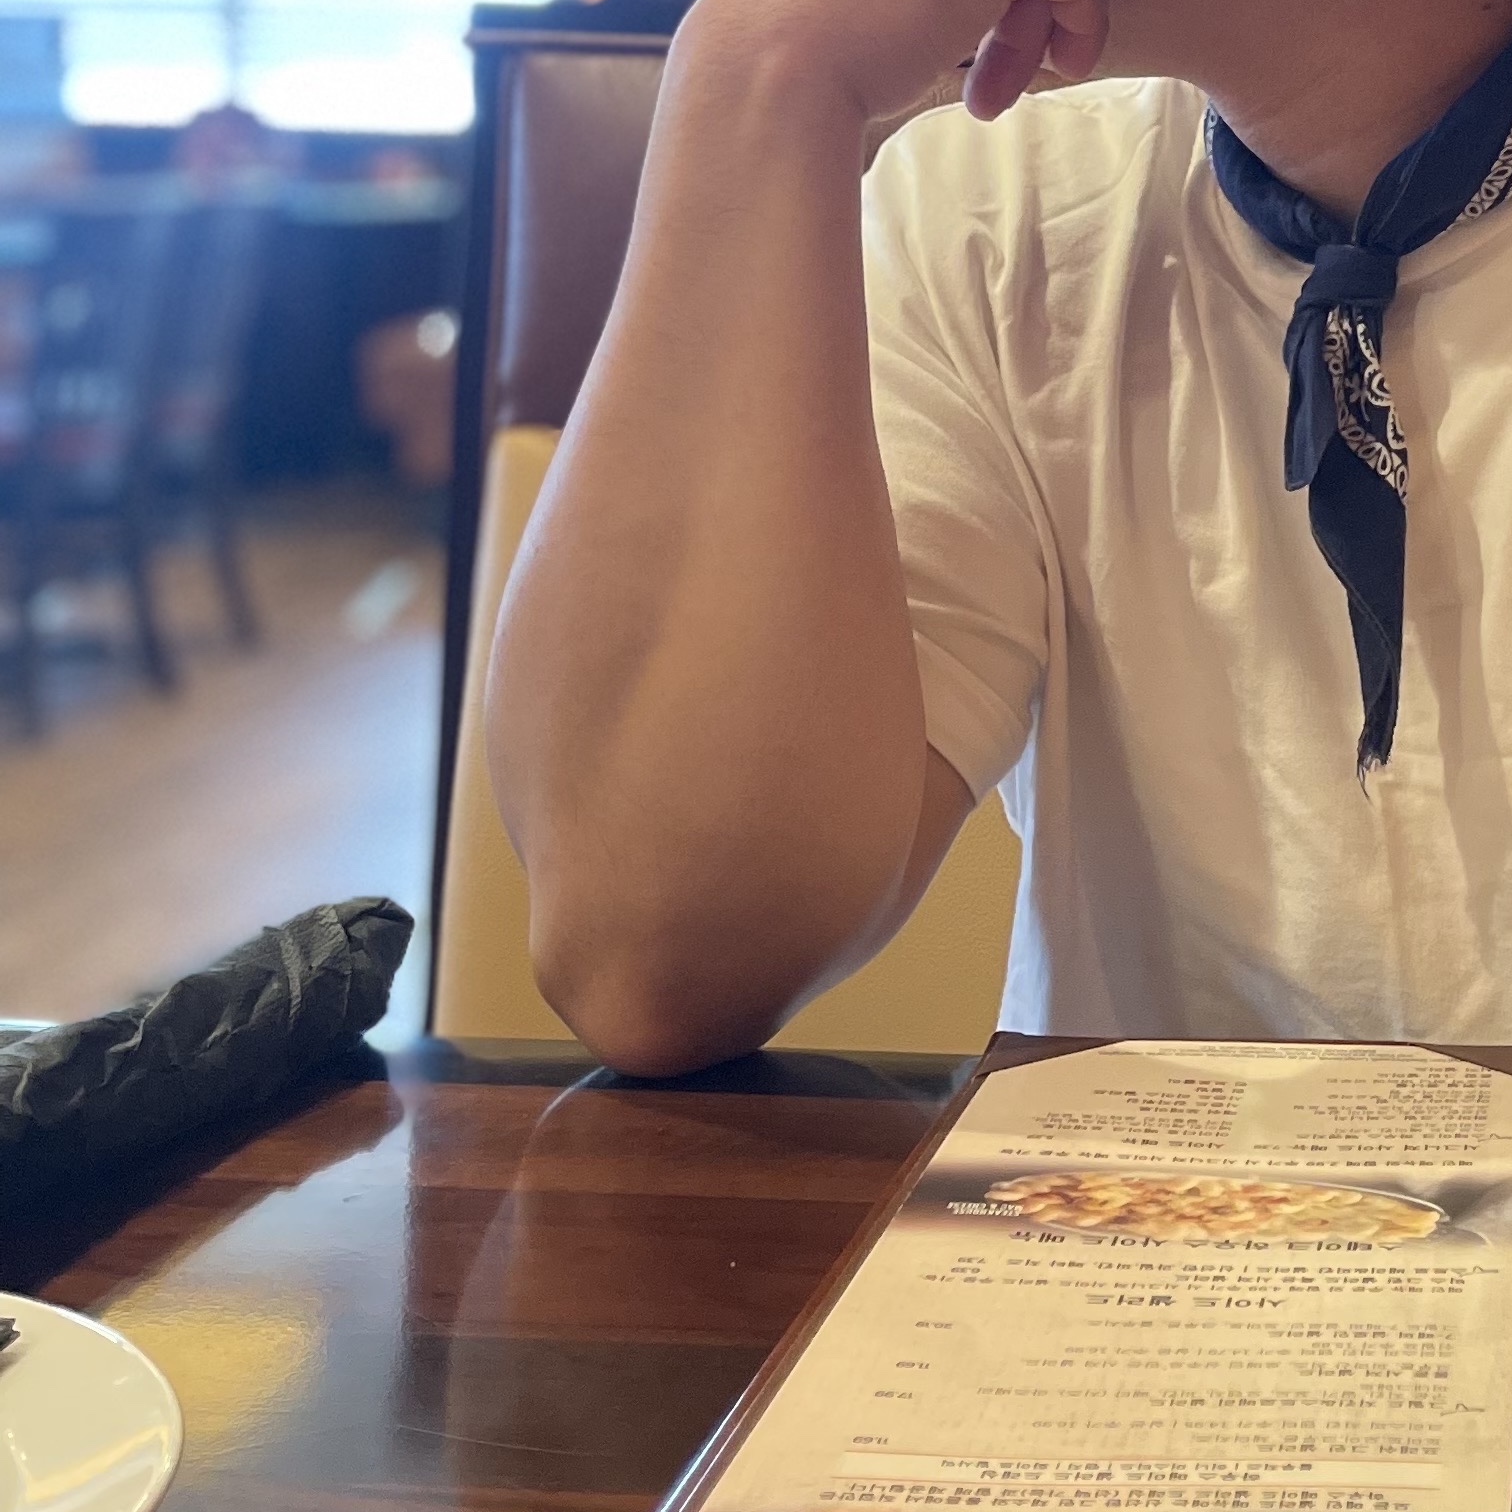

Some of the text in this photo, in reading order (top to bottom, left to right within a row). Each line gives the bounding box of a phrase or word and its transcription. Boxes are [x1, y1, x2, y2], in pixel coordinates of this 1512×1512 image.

[1007, 1231, 1403, 1254] 스테이크 하우스 사이드 메뉴
[1085, 1294, 1290, 1311] 사이드 샐러드
[1256, 1443, 1316, 1453] 샐러드
[1329, 1445, 1370, 1454] 그린
[980, 1469, 1261, 1483] 하우스 메이드 샐러드 드레싱
[1325, 1492, 1384, 1501] 하우스
[1105, 1497, 1161, 1508] 신선한
[1259, 1499, 1316, 1510] 샐러드
[1326, 1501, 1363, 1511] 메인
